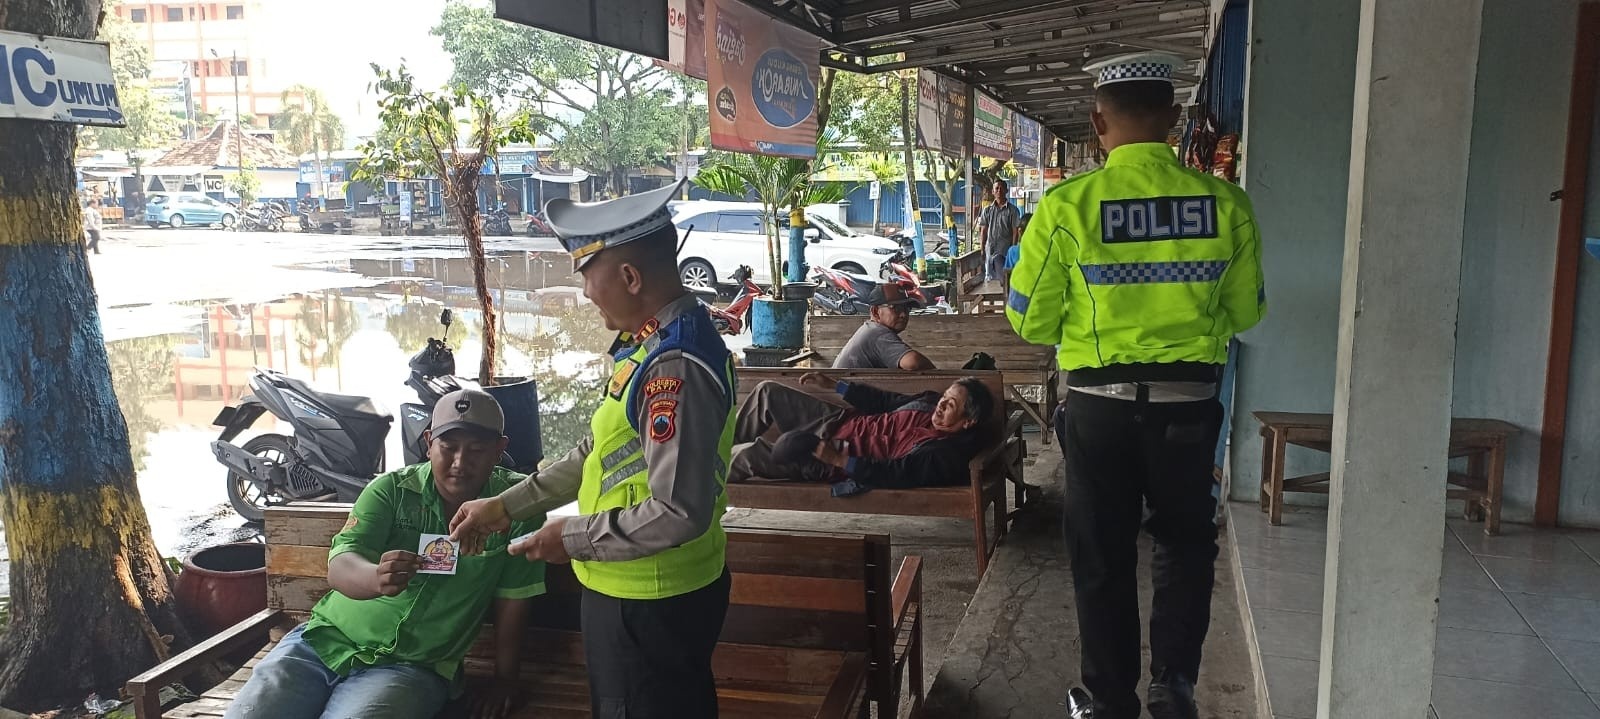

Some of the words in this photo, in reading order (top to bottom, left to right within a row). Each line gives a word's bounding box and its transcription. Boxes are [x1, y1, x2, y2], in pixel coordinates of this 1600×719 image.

[0, 44, 57, 107] C
[57, 79, 119, 107] UMUM
[206, 180, 222, 190] WC
[1103, 198, 1214, 240] POLISI
